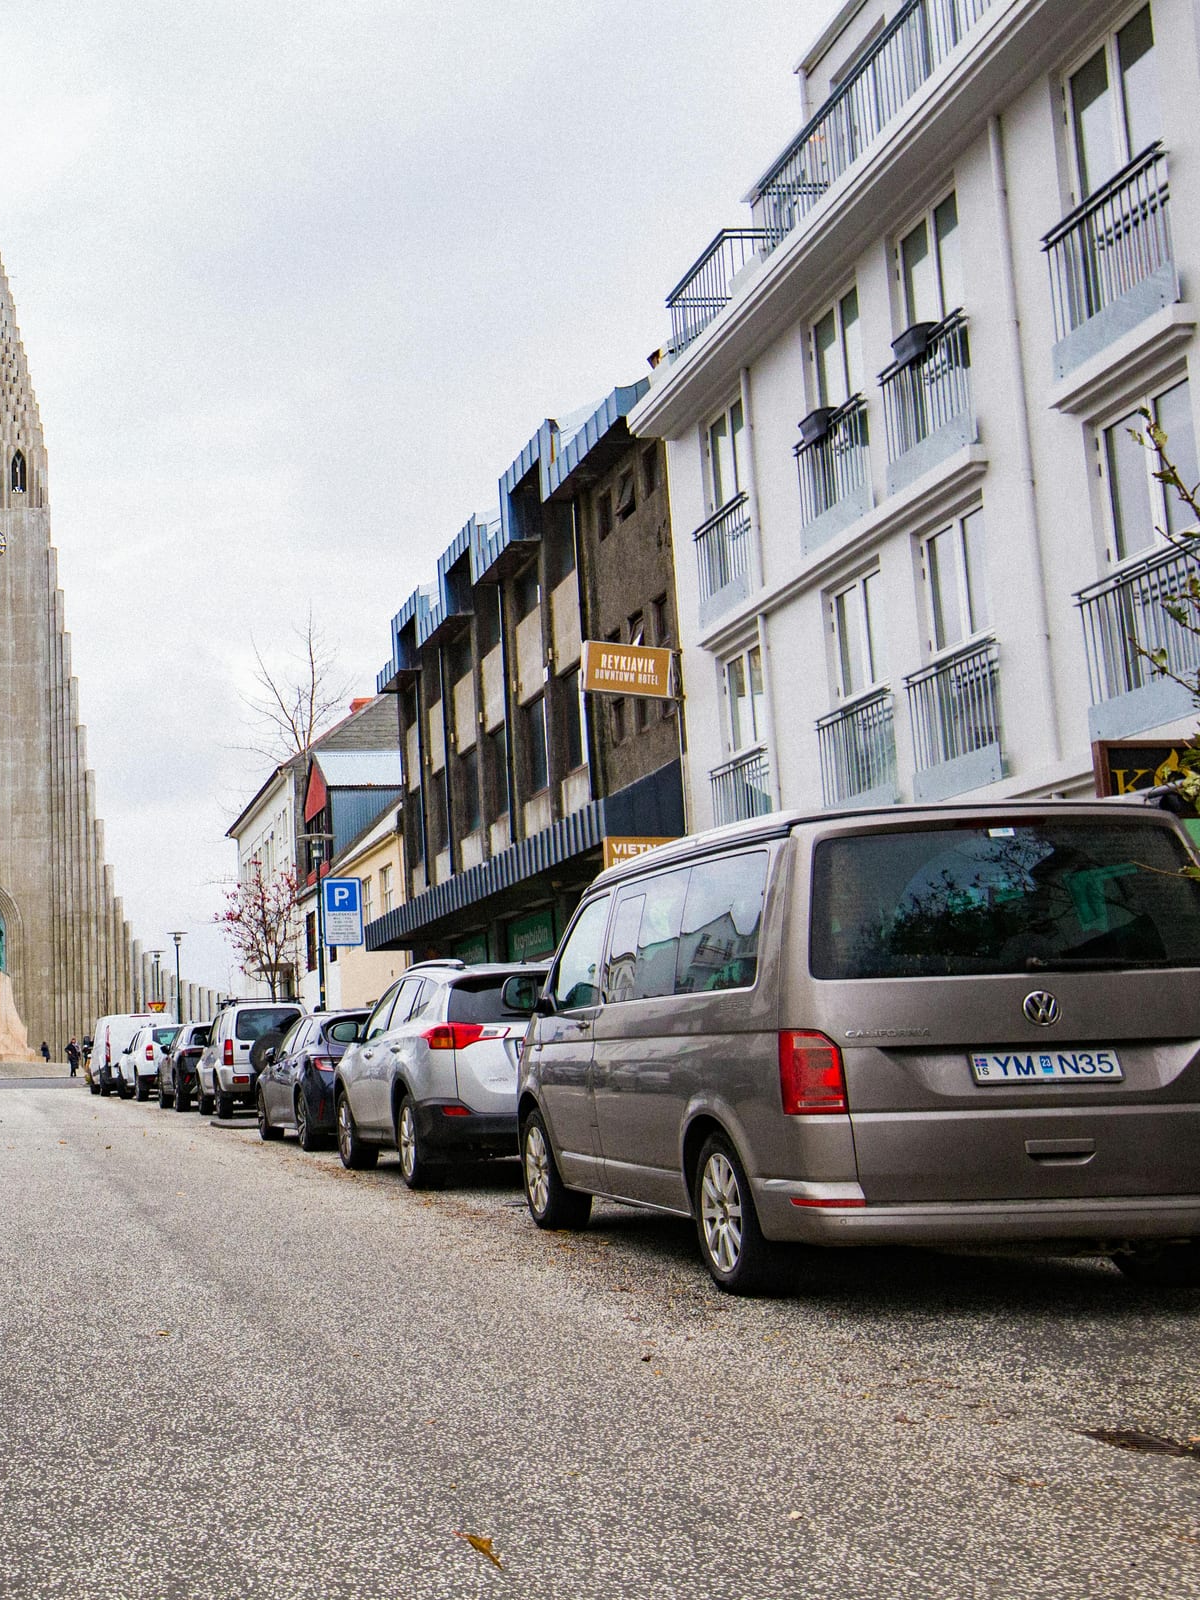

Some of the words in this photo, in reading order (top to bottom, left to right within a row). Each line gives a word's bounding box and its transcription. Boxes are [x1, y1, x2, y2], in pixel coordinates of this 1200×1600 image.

[601, 654, 655, 674] REYKJAVIK
[595, 668, 635, 683] DOWNTOWN
[638, 673, 659, 686] HOTEL
[845, 1027, 931, 1039] CALIFORNIA
[992, 1055, 1036, 1076] YM
[1057, 1053, 1114, 1075] N35
